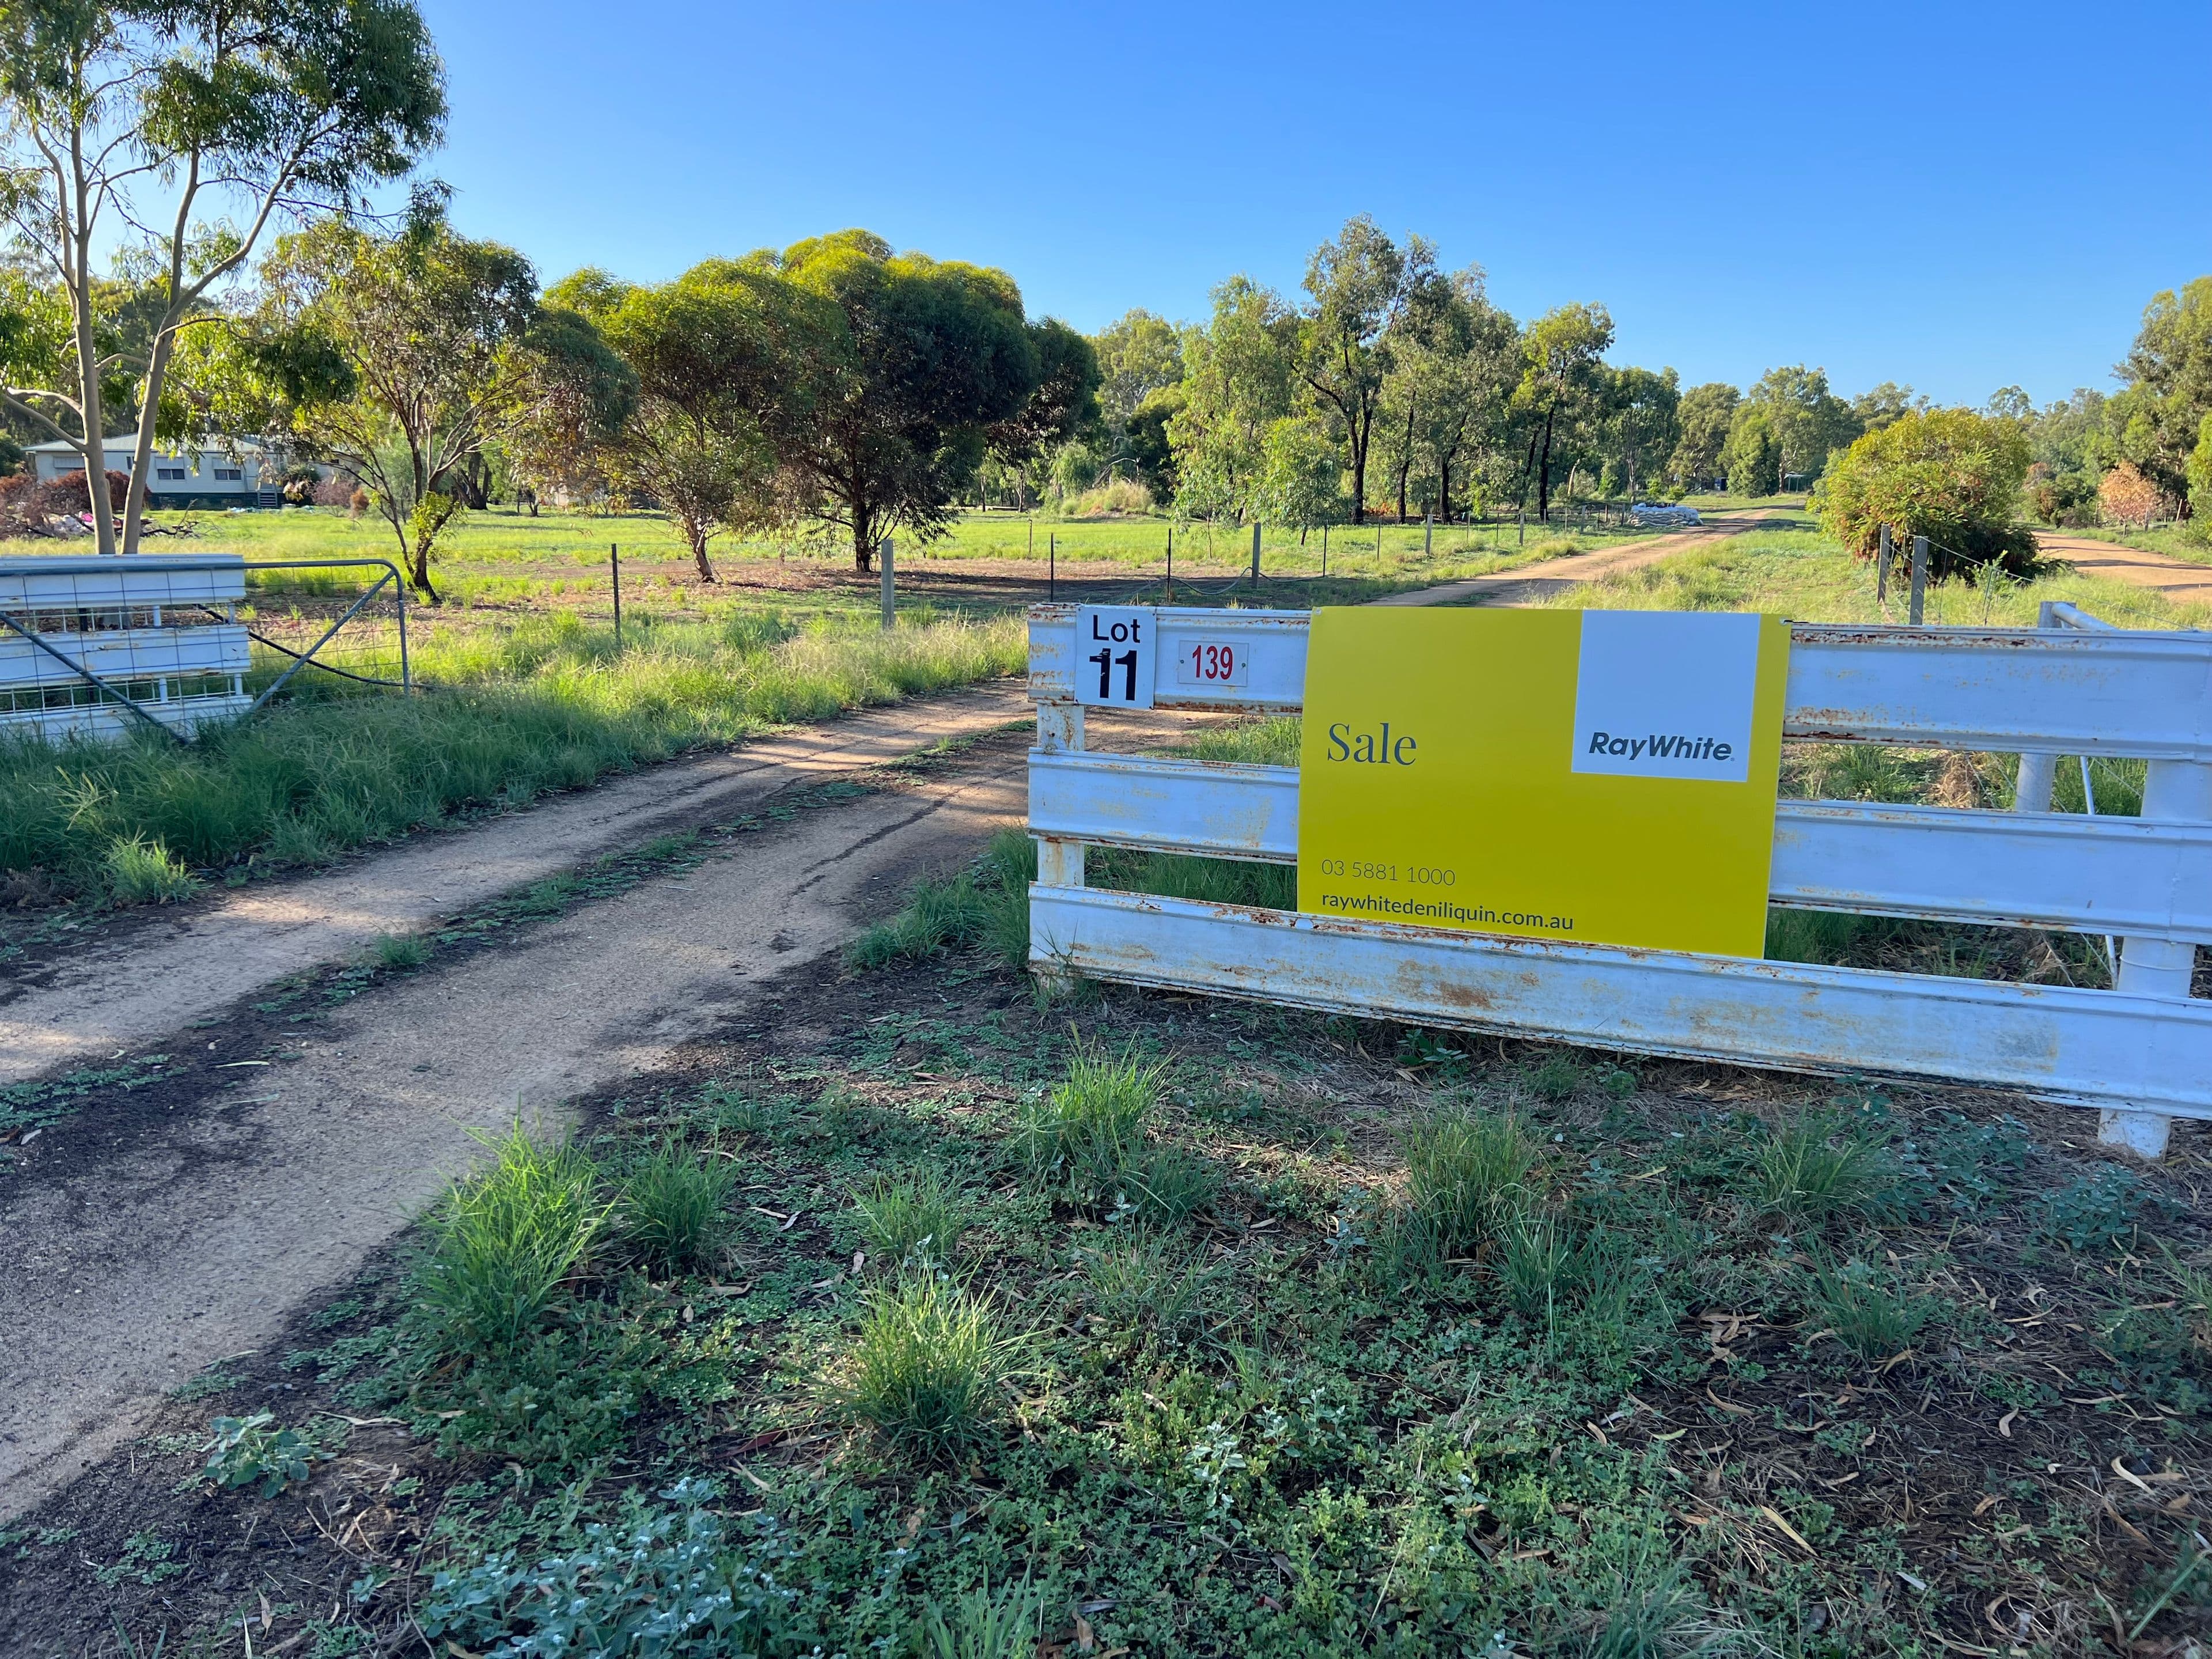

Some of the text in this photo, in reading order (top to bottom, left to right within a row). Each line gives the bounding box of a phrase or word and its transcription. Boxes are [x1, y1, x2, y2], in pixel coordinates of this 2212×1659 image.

[1093, 614, 1141, 643] Lot
[1089, 647, 1137, 701] 11
[1191, 645, 1233, 680] 139
[1327, 722, 1417, 766] Sale
[1588, 732, 1733, 762] RayWhite
[1321, 858, 1456, 886] 03 5881 1000
[1321, 892, 1574, 931] raywhitedeniliquin.com.au
